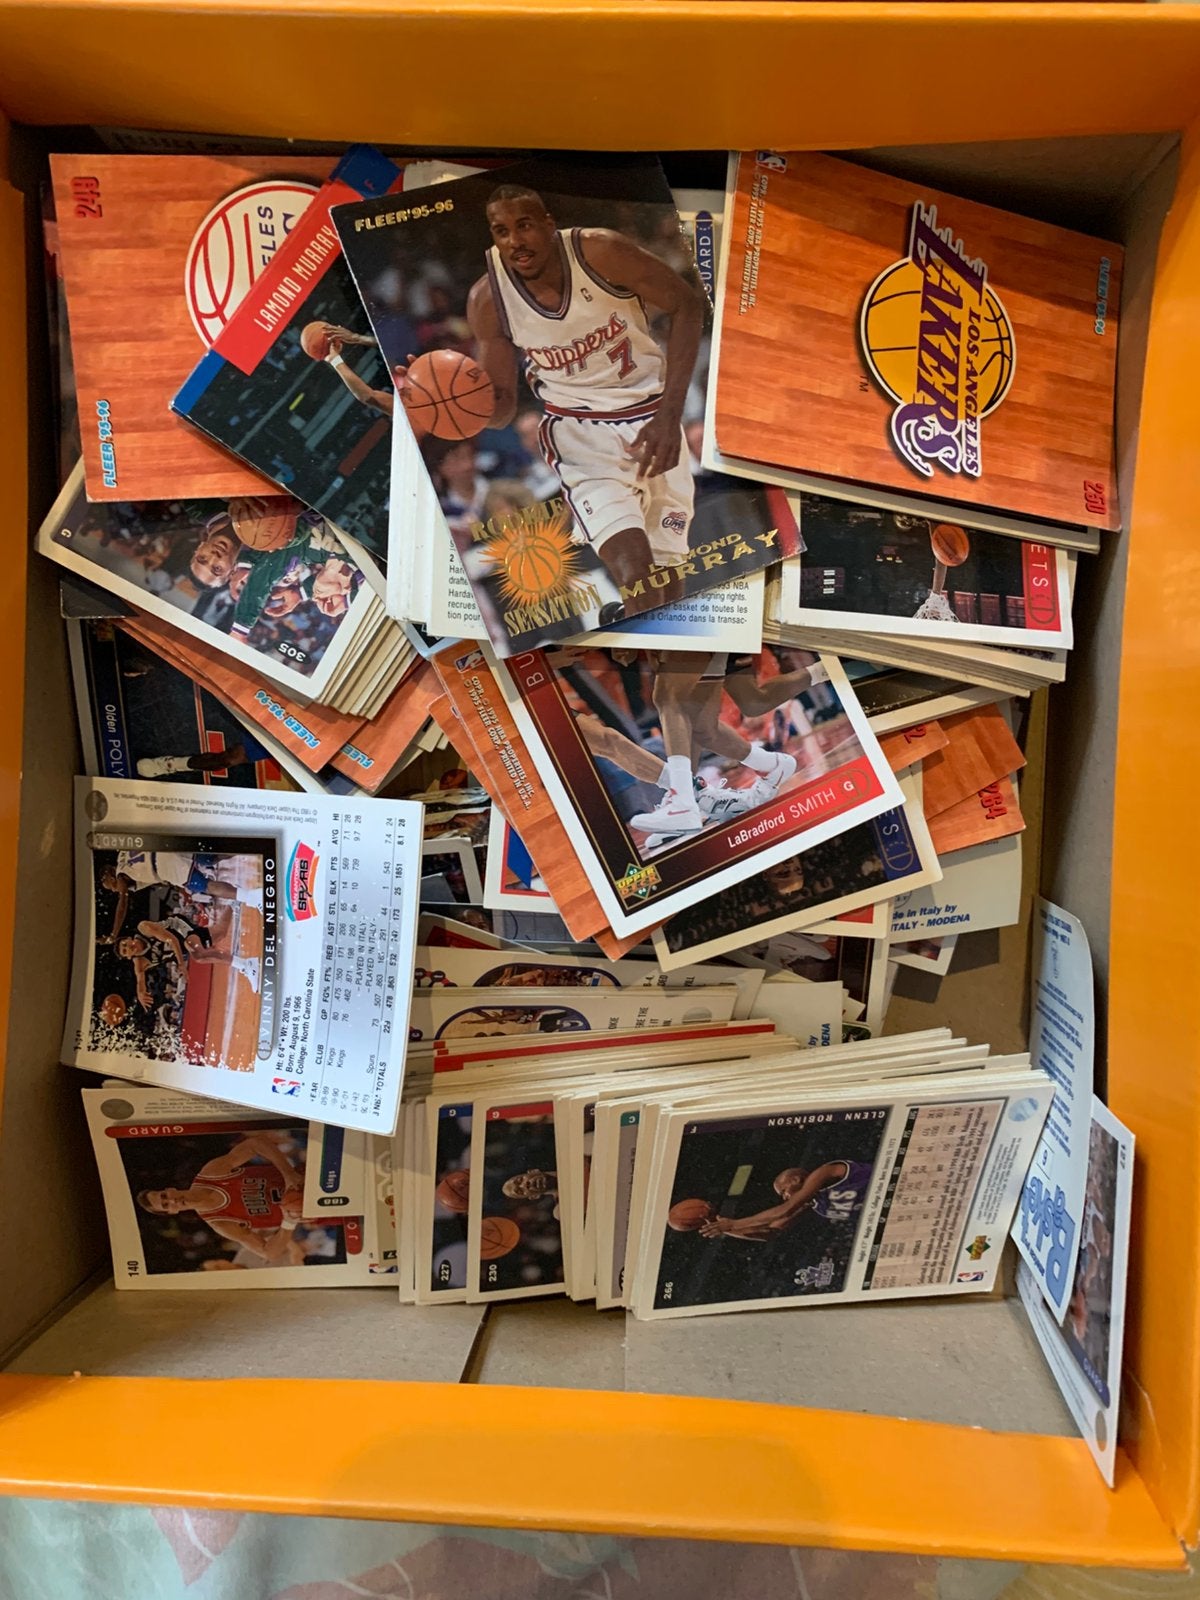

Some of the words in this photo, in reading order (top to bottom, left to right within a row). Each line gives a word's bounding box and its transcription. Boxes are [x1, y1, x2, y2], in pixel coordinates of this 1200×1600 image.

[755, 229, 763, 244] NBA
[744, 251, 752, 280] PRINTED
[750, 247, 760, 290] PROPERTIES,
[253, 277, 302, 332] LAMOND
[291, 225, 339, 280] MURRAY
[743, 283, 749, 291] IN
[739, 293, 748, 315] U.S.A.
[748, 294, 756, 308] INC.
[891, 201, 987, 476] LAKERS
[966, 307, 981, 357] LOS
[526, 312, 628, 377] Clippers
[606, 336, 638, 380] 7
[96, 400, 111, 440] '95-96
[964, 355, 980, 475] ANGELES
[102, 442, 118, 488] FLEER
[470, 497, 563, 542] ROOKIE
[61, 528, 72, 538] G
[450, 554, 454, 562] 2
[619, 528, 778, 599] MURRAY
[1031, 544, 1049, 587] ETS
[733, 581, 749, 589] NBA
[448, 601, 476, 609] recrues
[701, 592, 724, 601] signing
[727, 594, 746, 602] rights.
[448, 611, 461, 619] tion
[464, 613, 480, 621] pour
[503, 584, 603, 637] SENSATION
[658, 613, 686, 621] Orlando
[709, 615, 715, 623] la
[717, 616, 747, 624] transac-
[279, 642, 306, 662] 305
[105, 704, 117, 733] Olden
[283, 715, 320, 749] FLEER
[108, 739, 124, 777] POLY
[470, 689, 479, 706] 1995
[479, 707, 490, 726] FLEER
[500, 750, 515, 778] PRINTED
[513, 779, 520, 787] IN
[518, 789, 530, 810] U.S.A.
[487, 707, 498, 724] 1995
[495, 725, 506, 740] NBA
[504, 741, 527, 781] PROPERTIES,
[524, 783, 535, 797] INC.
[727, 812, 786, 848] LaBradford
[789, 788, 836, 818] SMITH
[843, 781, 854, 791] G
[96, 836, 143, 848] GUARD
[266, 859, 275, 922] NEGRO
[907, 909, 916, 917] in
[920, 906, 942, 915] Italy
[945, 904, 957, 912] by
[927, 914, 970, 927] MODENA
[372, 1019, 379, 1027] 73
[381, 907, 387, 915] 44
[386, 818, 392, 826] 24
[327, 1047, 336, 1066] Kings
[332, 1012, 339, 1021] 80
[344, 814, 351, 822] 28
[337, 1050, 346, 1068] Kings
[342, 1014, 349, 1022] 76
[352, 882, 358, 890] 10
[355, 815, 361, 823] 28
[358, 944, 365, 953] IN
[266, 935, 275, 967] DEL
[376, 1062, 386, 1091] TOTALS
[395, 887, 401, 895] 25
[399, 819, 405, 827] 28
[306, 969, 314, 987] State
[323, 967, 332, 982] FT%
[356, 956, 364, 985] PLAYED
[366, 958, 375, 987] PLAYED
[283, 996, 291, 1009] lbs.
[293, 996, 301, 1013] 1966
[303, 989, 313, 1020] Carolina
[322, 986, 330, 1002] FG%
[261, 979, 273, 1037] VINNY
[282, 1010, 290, 1023] 200
[321, 1009, 327, 1020] GP
[289, 1024, 299, 1050] August
[300, 1022, 310, 1042] North
[286, 1053, 295, 1072] Born:
[296, 1044, 307, 1074] College:
[315, 1044, 324, 1065] CLUB
[449, 1108, 457, 1116] G
[492, 1111, 500, 1119] G
[767, 1114, 833, 1126] ROBINSON
[844, 1110, 886, 1121] GLENN
[128, 1126, 185, 1136] GUARD
[690, 1126, 697, 1134] F
[241, 1178, 270, 1215] BULLS
[127, 1259, 139, 1278] 140
[441, 1263, 450, 1281] 227
[488, 1264, 497, 1282] 230
[663, 1281, 674, 1300] 266
